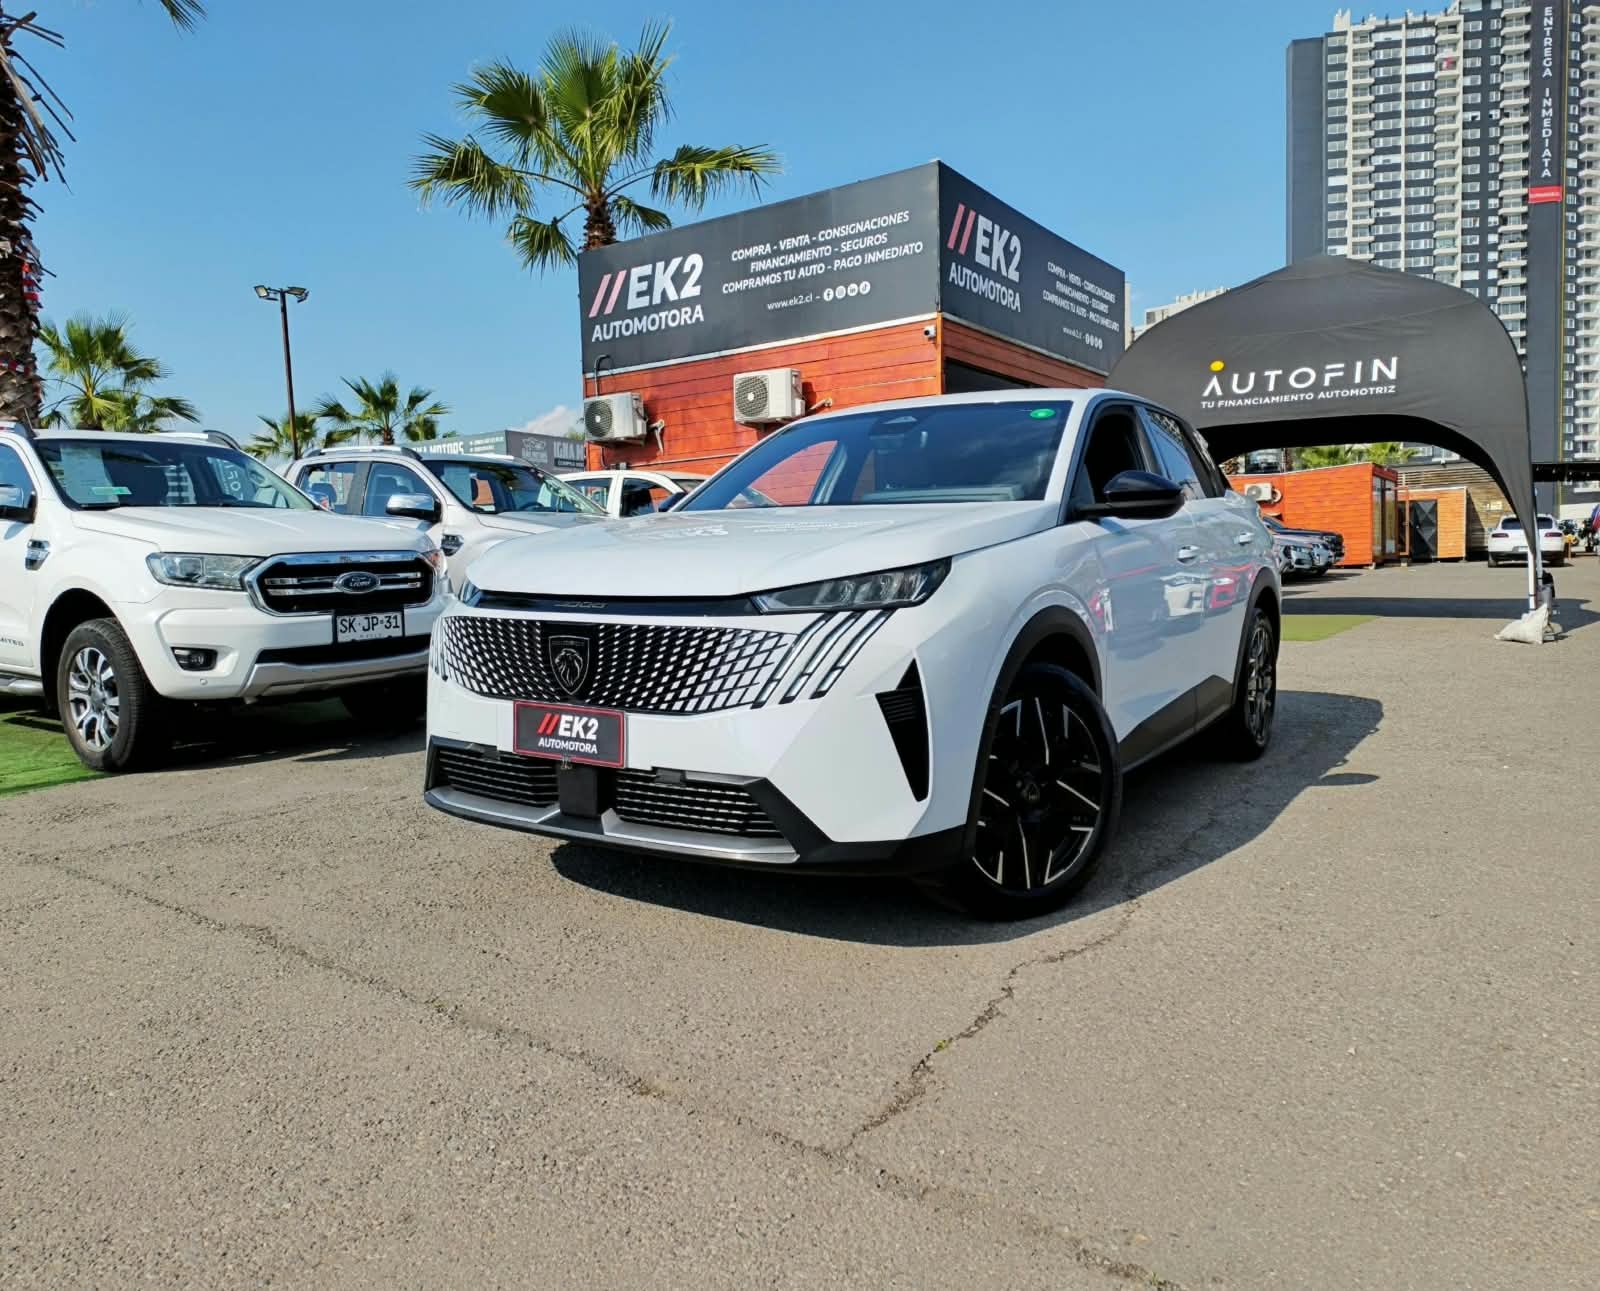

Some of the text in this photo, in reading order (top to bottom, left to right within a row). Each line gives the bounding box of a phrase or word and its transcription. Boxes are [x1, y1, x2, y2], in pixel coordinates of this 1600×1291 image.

[1541, 6, 1553, 177] ENTREGA INMEDIATA
[731, 210, 910, 262] COMPRA VENTA CONSIGNACIONES
[750, 232, 888, 273] FINANCIAMIENTO SEGUROS
[722, 241, 923, 294] COMPRAMOS TU AUTO PAGO INMEDIATO
[949, 262, 1021, 313] AUTOMOTORA
[767, 292, 813, 310] www.ek2.cl
[591, 304, 705, 343] AUTOMOTORA
[1201, 385, 1396, 409] TU FINANCIAMIENTO AUTOMOTRIZ
[1202, 356, 1399, 397] AUTOFIN
[538, 737, 598, 754] AUTOMOTORA
